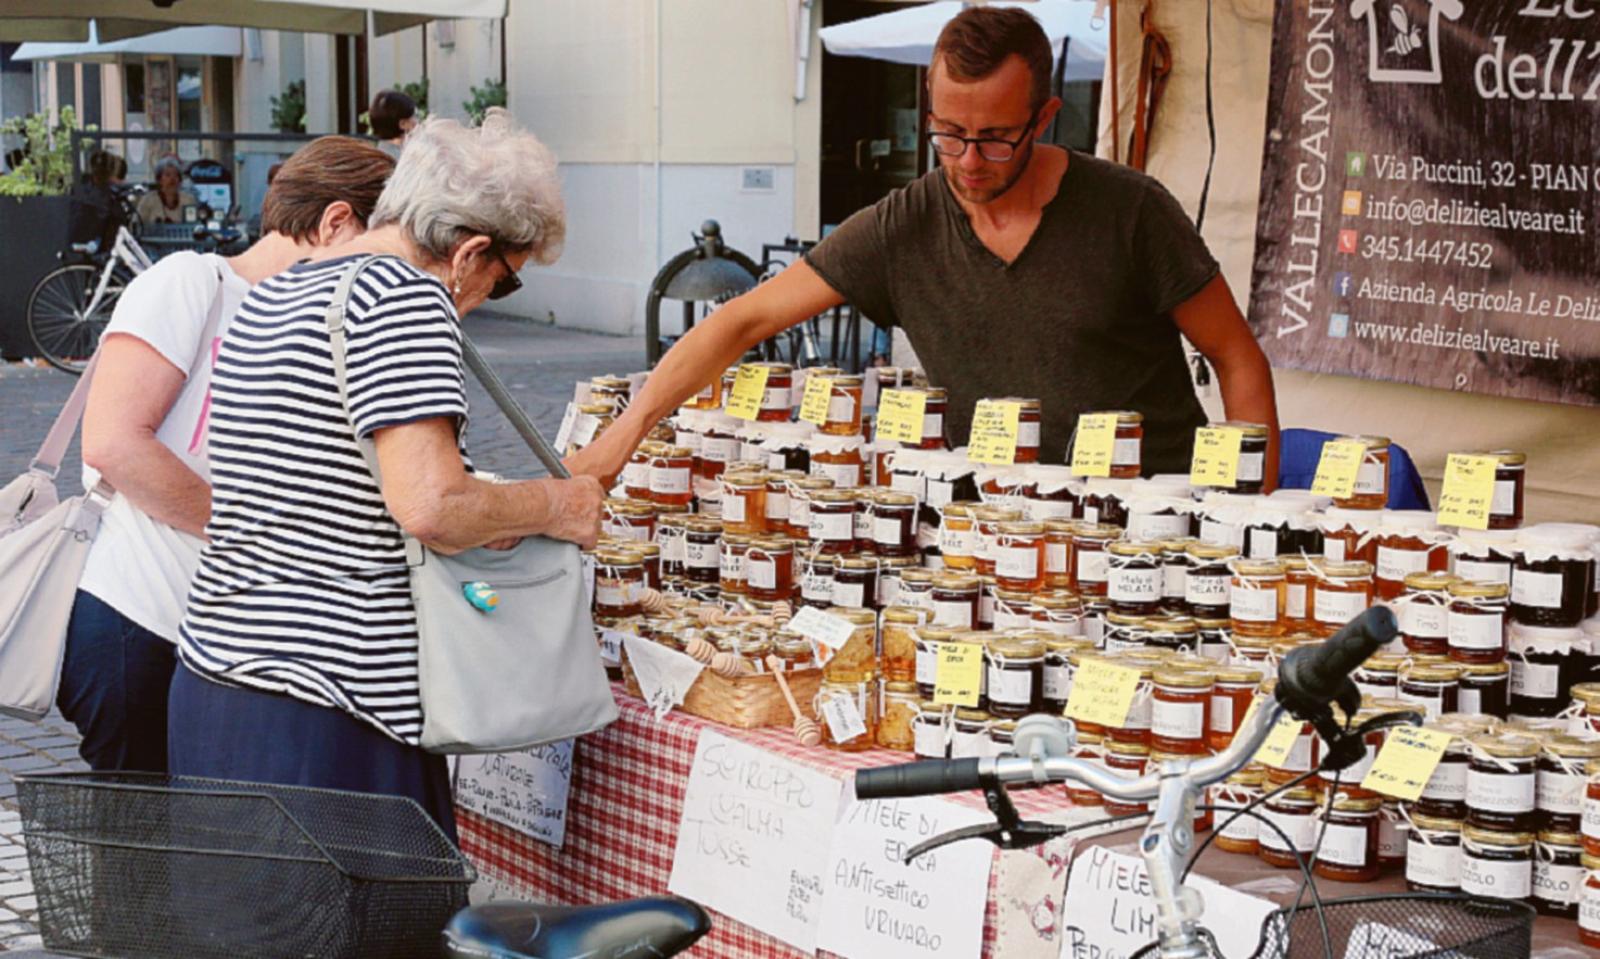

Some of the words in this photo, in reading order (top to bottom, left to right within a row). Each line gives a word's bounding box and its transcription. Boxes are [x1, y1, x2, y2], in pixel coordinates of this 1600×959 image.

[1276, 0, 1336, 339] VALLECAMON
[1371, 154, 1408, 180] Via
[1412, 156, 1487, 189] Puccini,
[1491, 161, 1516, 187] 32
[1530, 163, 1589, 191] PIAN
[1366, 194, 1586, 235] info@deliziealveare.it
[1361, 234, 1494, 268] 345.1447452
[1356, 277, 1436, 304] Azienda
[1439, 284, 1523, 313] Agricola
[1525, 291, 1551, 316] Le
[1354, 320, 1560, 360] www.deliziealveare.it
[884, 838, 937, 872] ERCA
